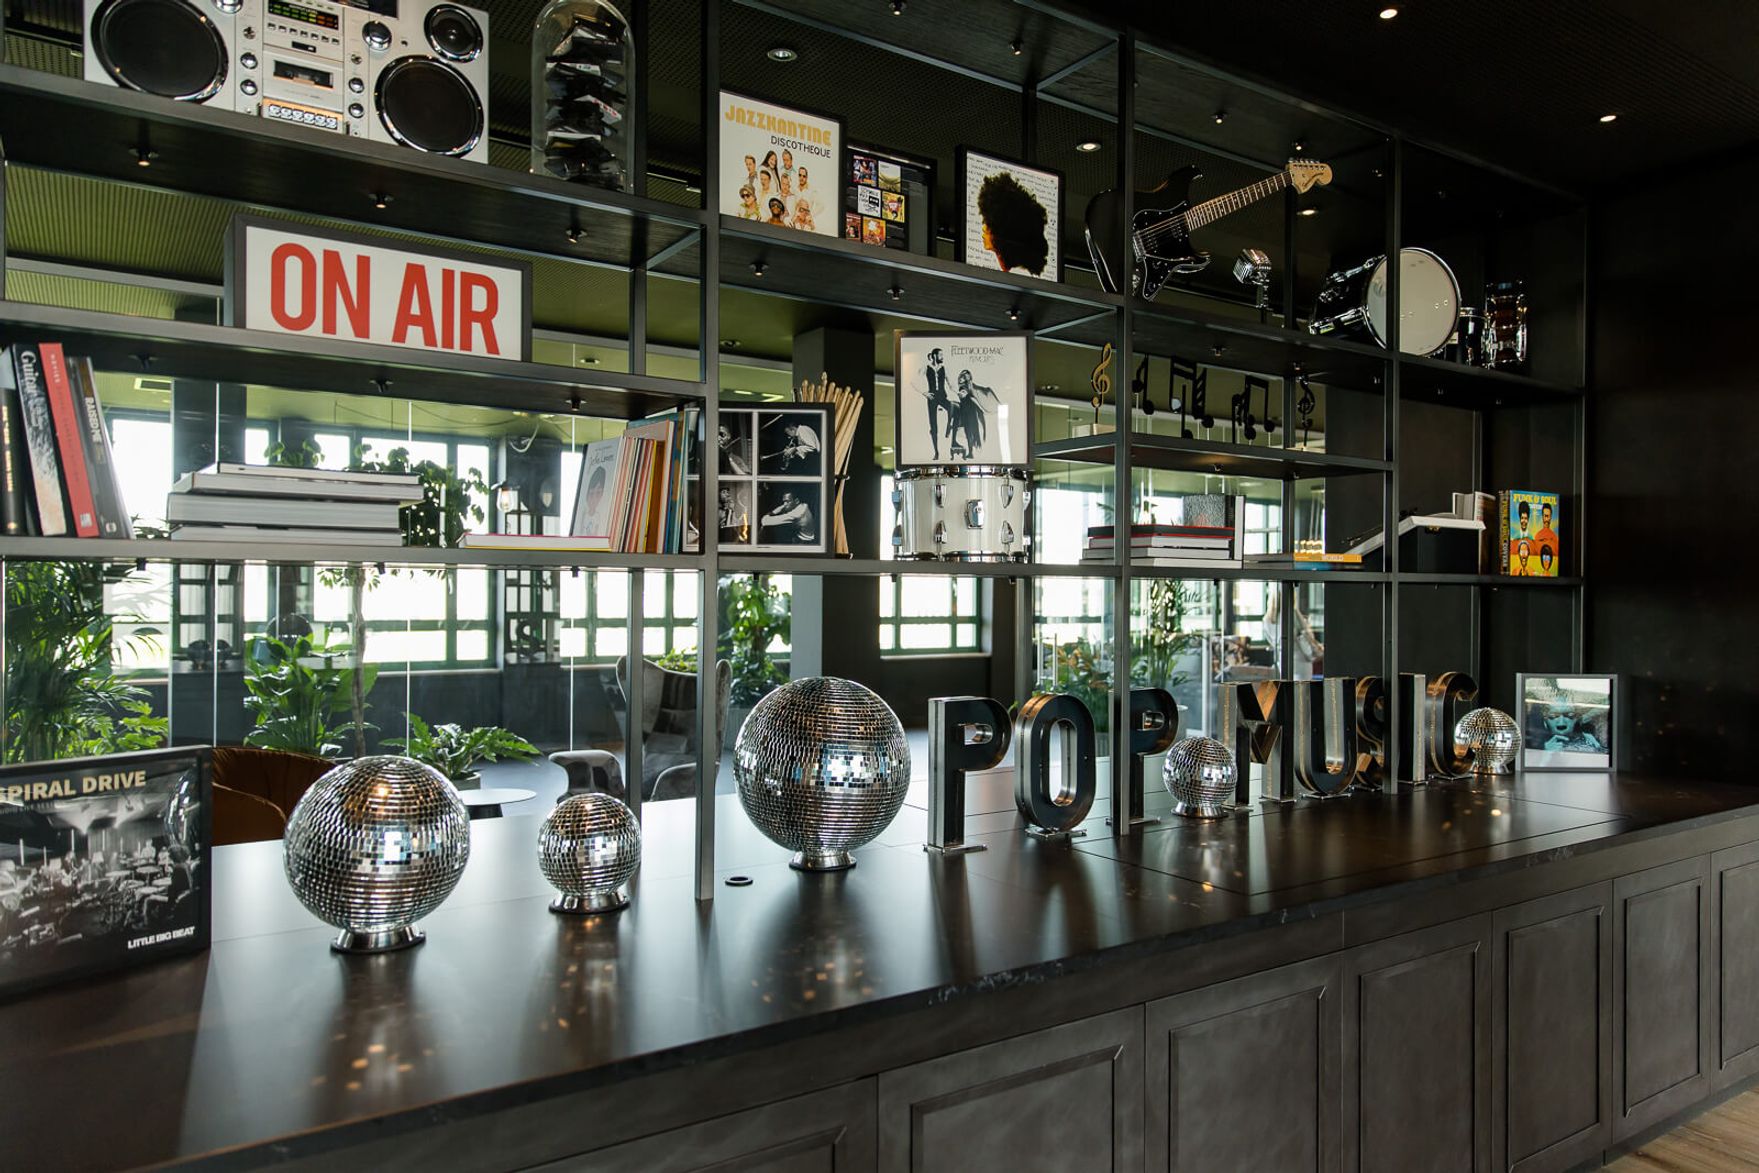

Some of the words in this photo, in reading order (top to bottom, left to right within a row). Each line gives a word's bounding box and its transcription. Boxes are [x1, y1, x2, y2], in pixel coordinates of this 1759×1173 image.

[725, 104, 832, 147] JAZZKANTINE
[770, 135, 831, 159] DISCOTHEQUE
[270, 242, 371, 339] ON
[391, 263, 500, 356] AIR
[20, 350, 38, 398] Guitar
[85, 396, 100, 429] RAISED
[82, 770, 147, 794] DRIVE
[926, 687, 1179, 850] POP
[127, 935, 156, 950] LITTLE
[156, 931, 172, 943] BIG
[172, 925, 196, 939] BEAT
